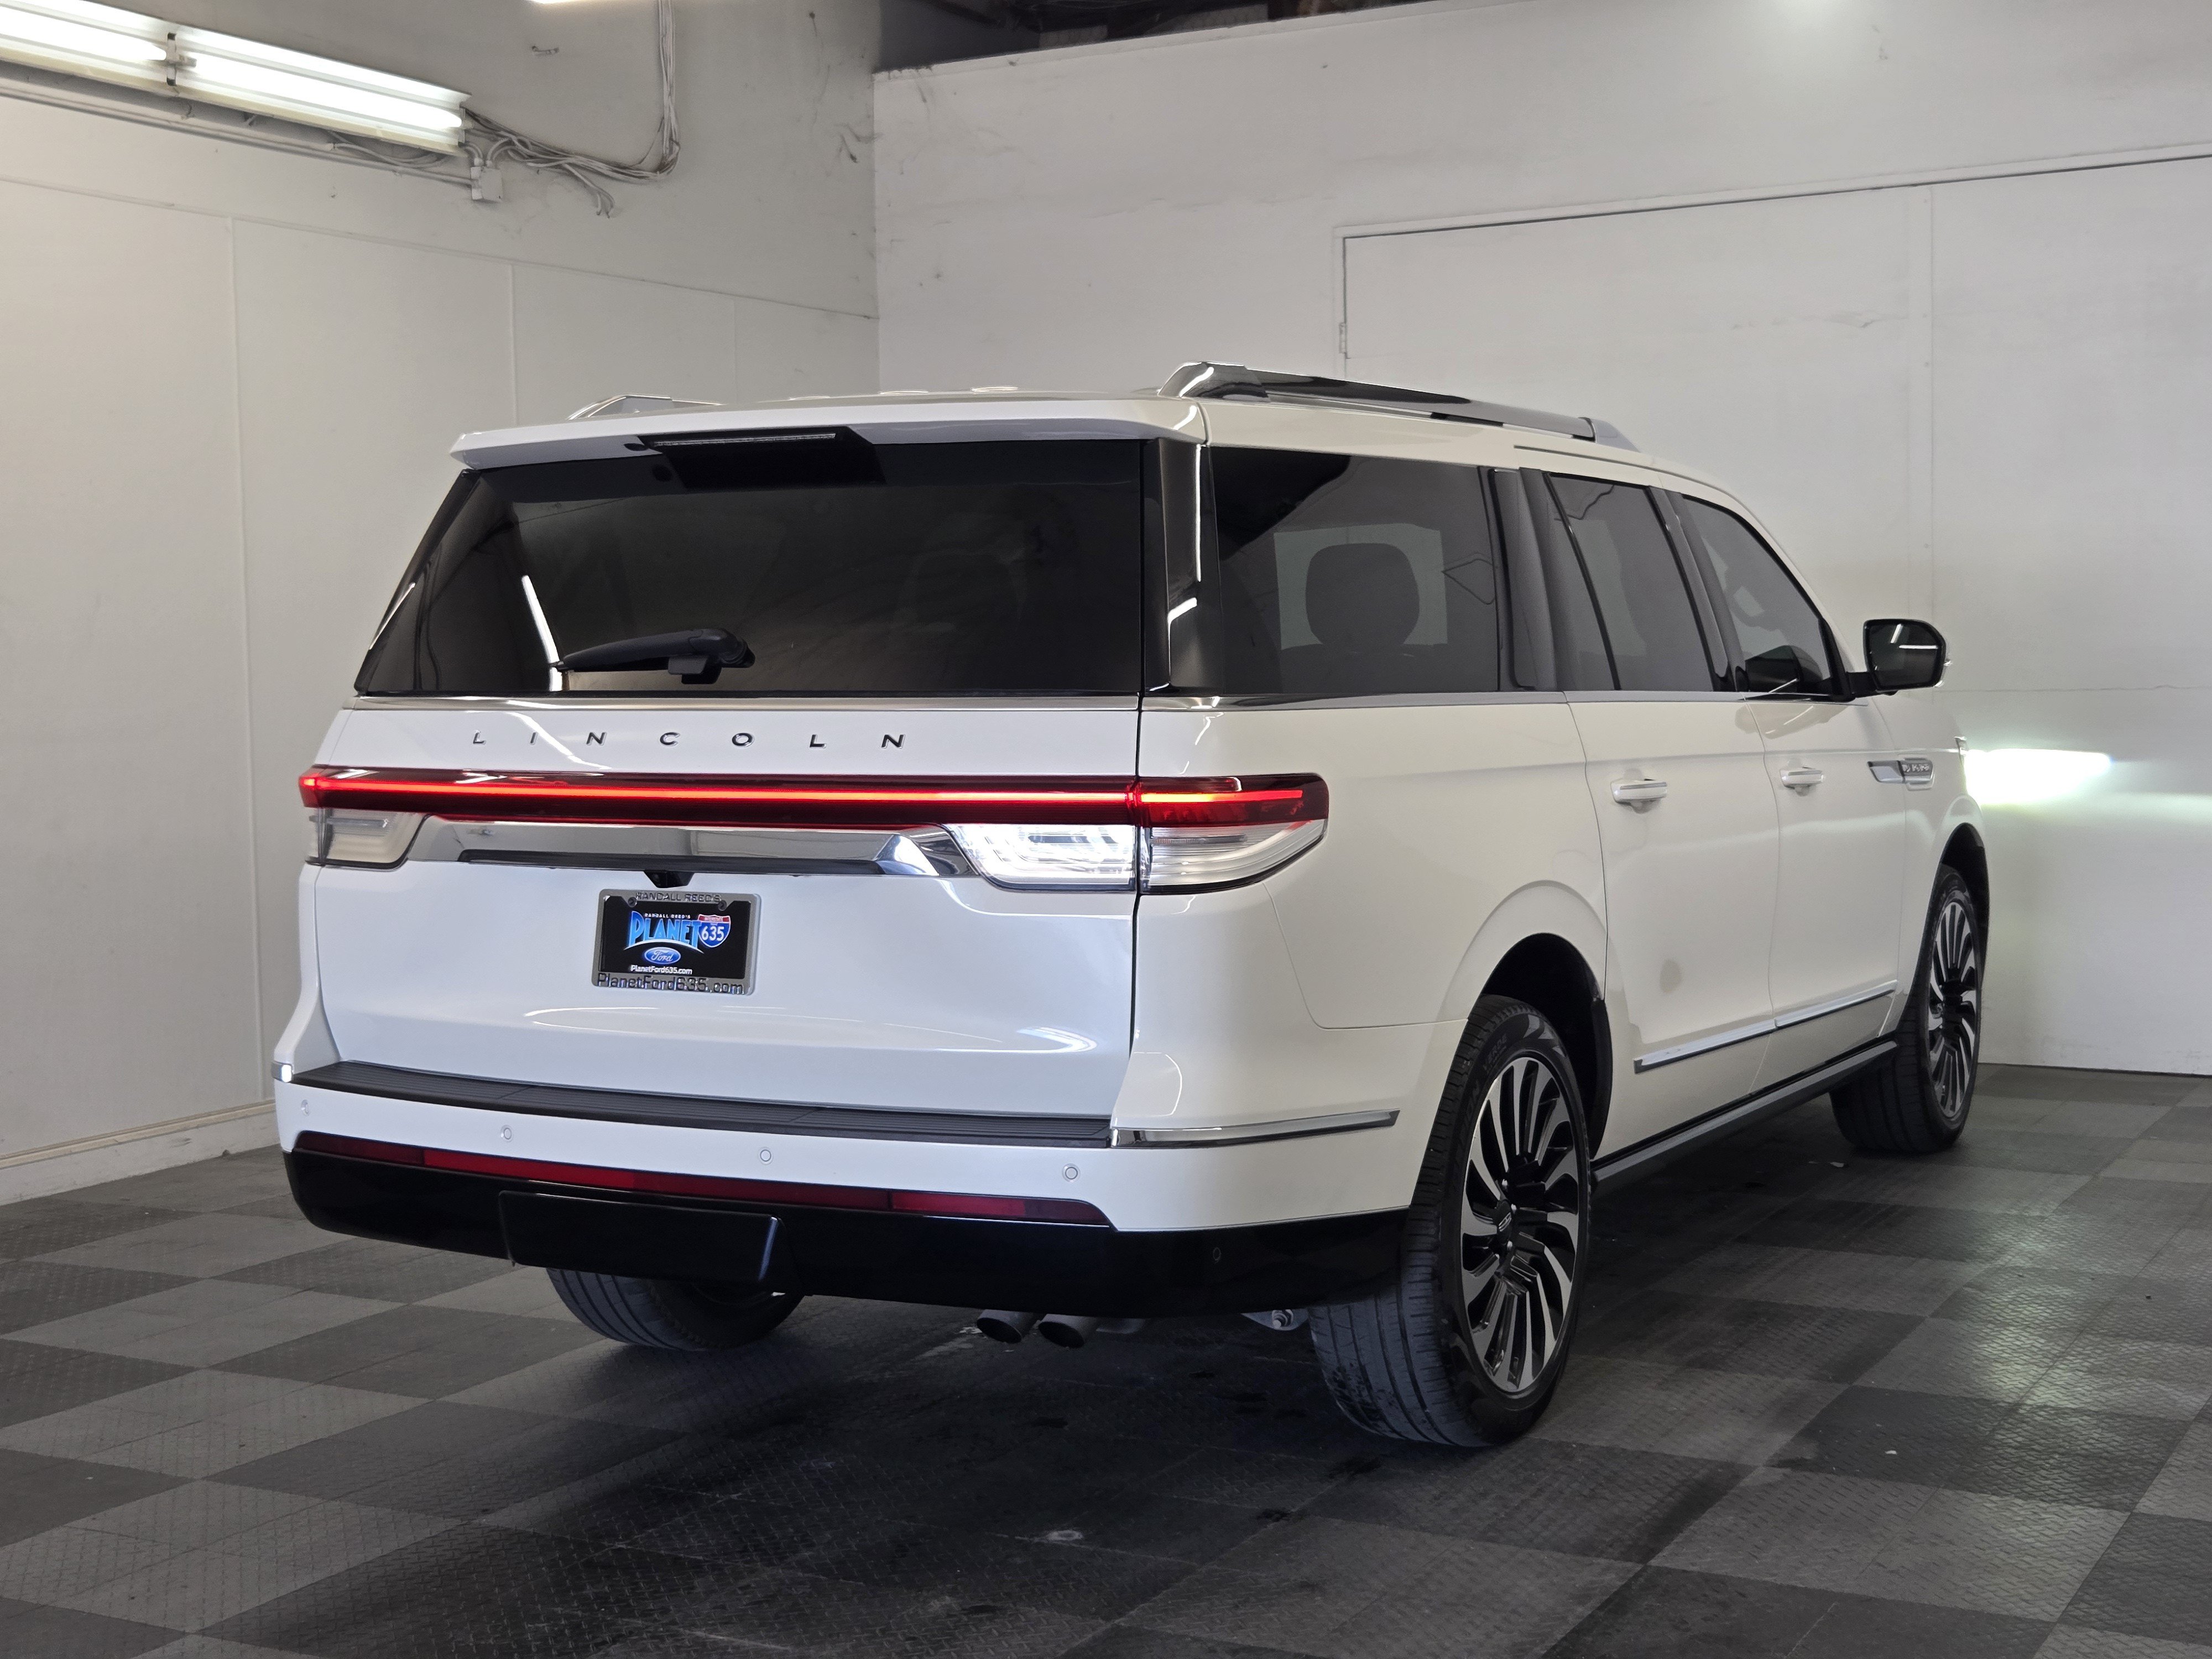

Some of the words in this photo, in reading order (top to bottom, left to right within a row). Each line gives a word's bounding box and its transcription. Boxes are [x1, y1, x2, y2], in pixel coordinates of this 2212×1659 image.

[473, 730, 906, 749] LINCOLN
[637, 891, 681, 901] RANDALL
[685, 893, 722, 902] REED'S
[628, 910, 702, 948] PLANET
[701, 926, 725, 941] 635
[651, 950, 673, 962] Ford
[630, 964, 693, 975] PlanetFord635.com
[597, 972, 744, 995] PlanetFord635.com
